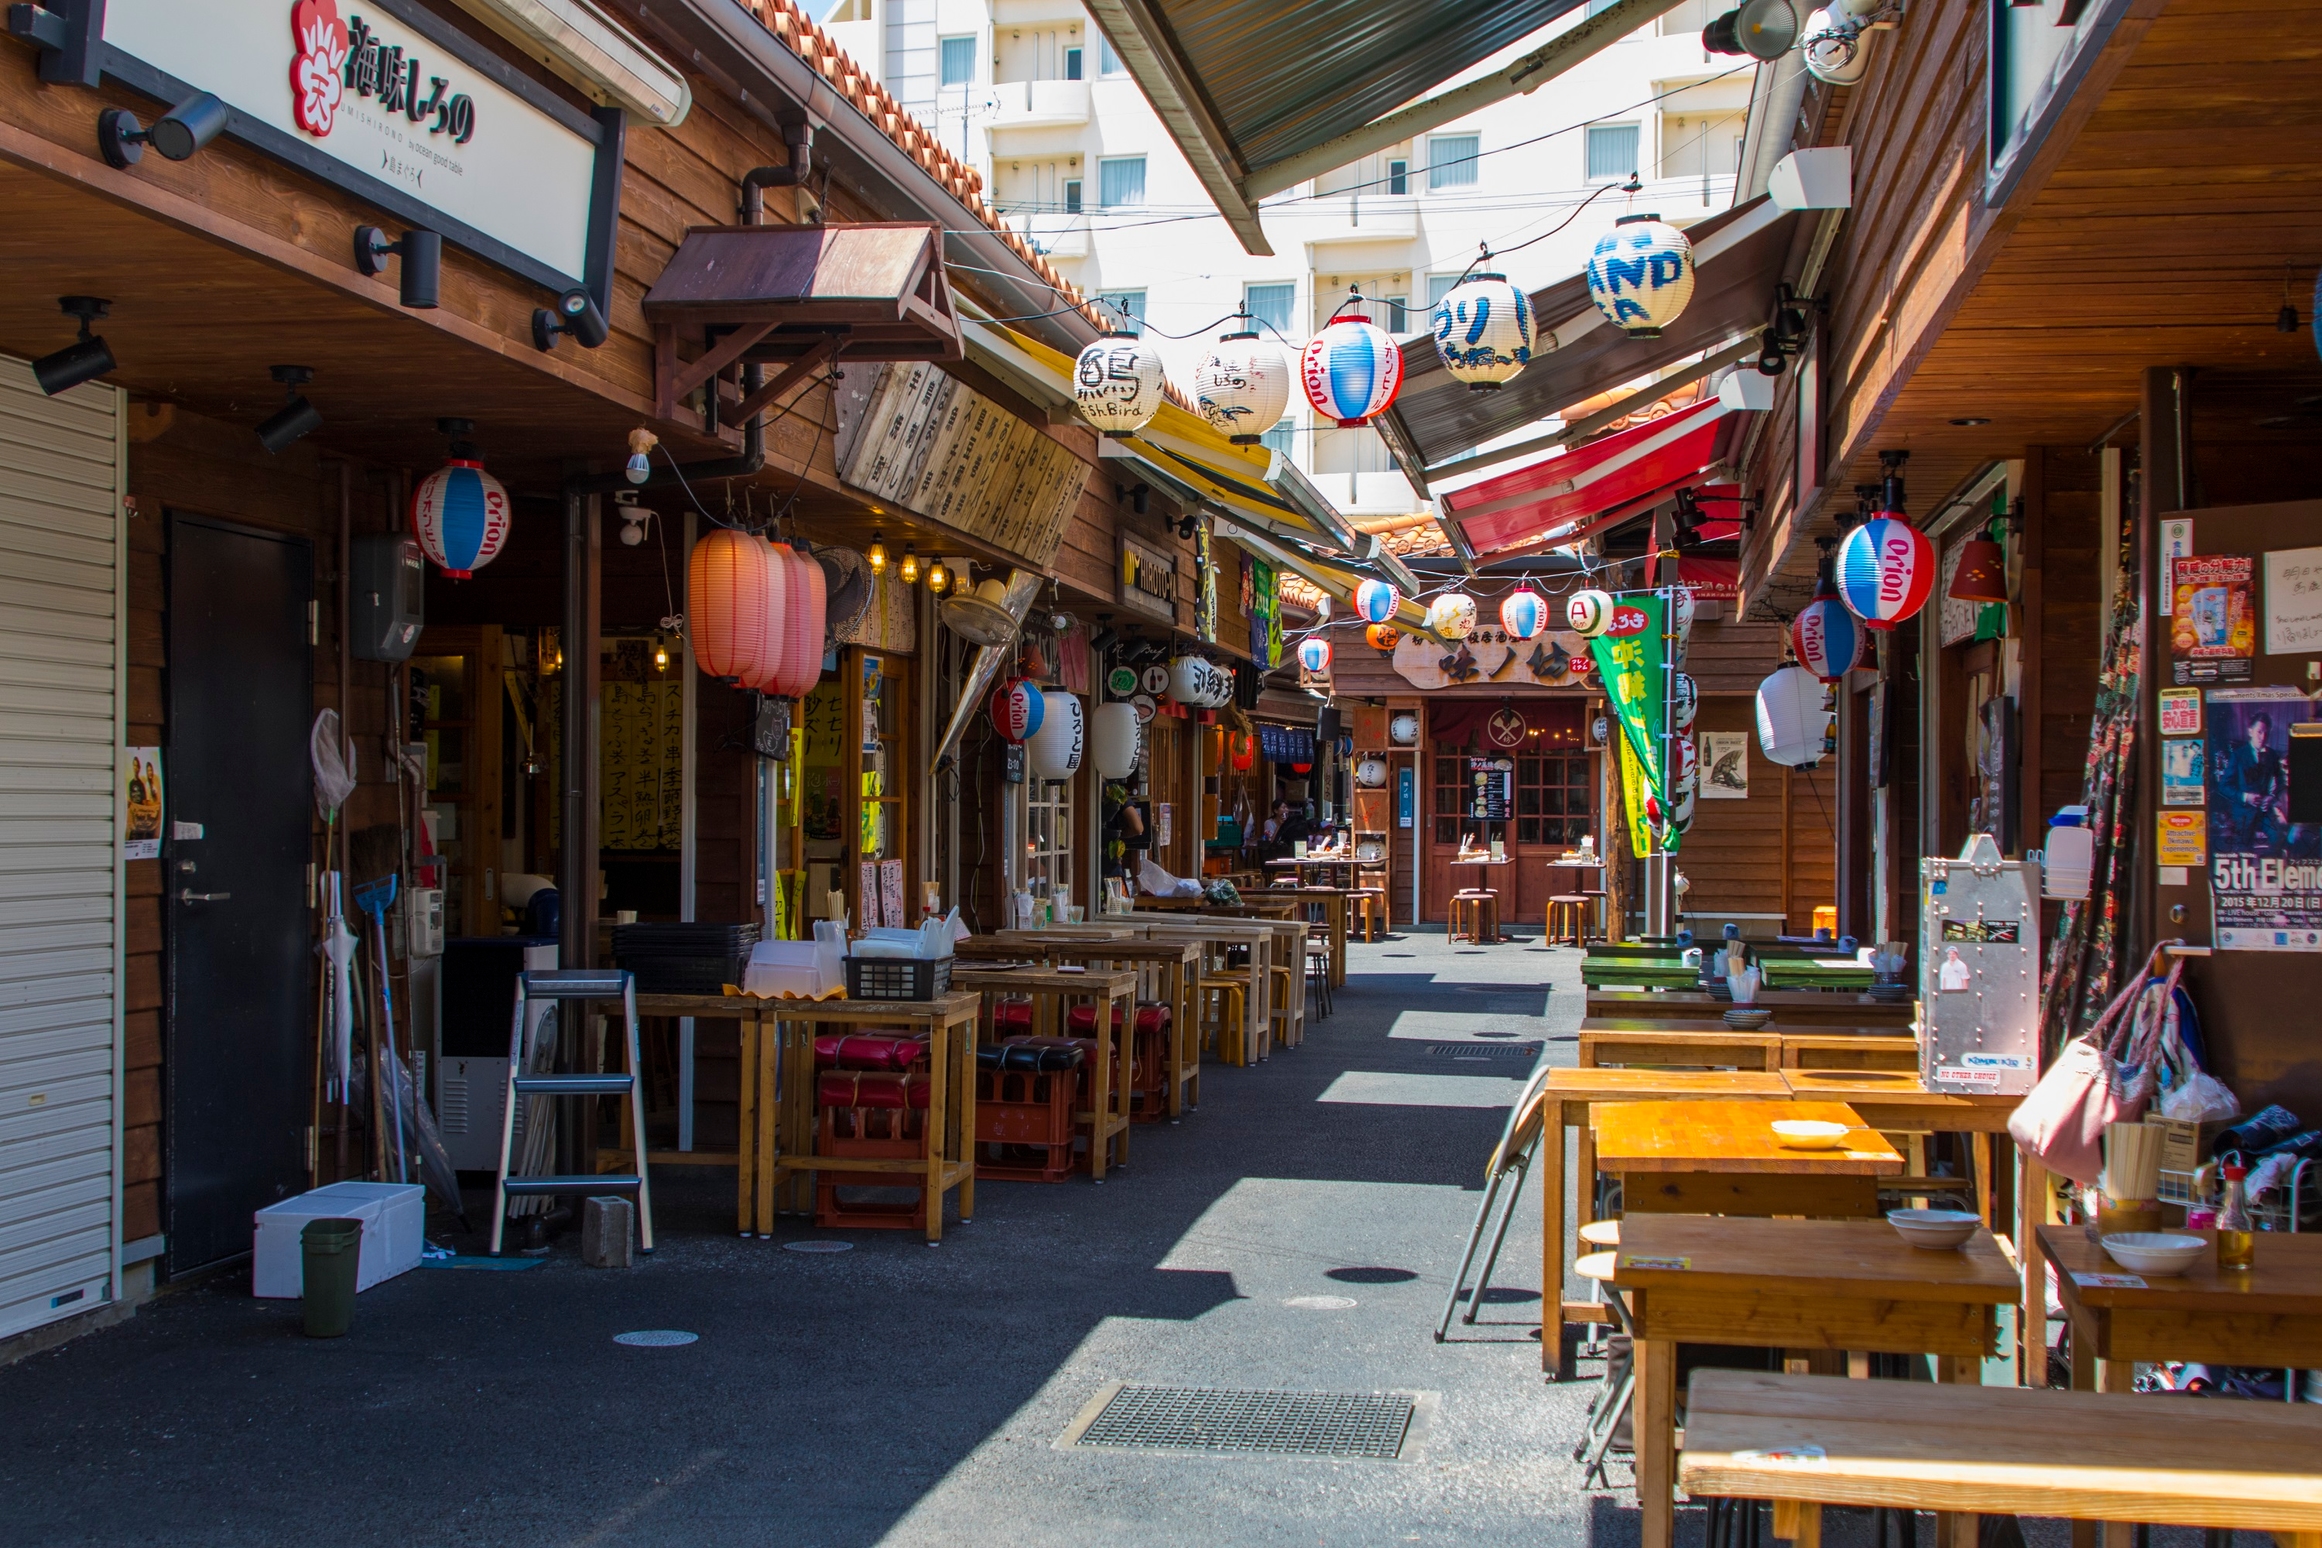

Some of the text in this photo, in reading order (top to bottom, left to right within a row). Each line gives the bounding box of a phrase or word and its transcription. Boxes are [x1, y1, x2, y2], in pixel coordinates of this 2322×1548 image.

[344, 15, 476, 144] 海味しろの
[341, 102, 403, 143] UMISHIRONO
[415, 143, 433, 160] ocean
[433, 153, 449, 168] good
[448, 158, 463, 176] table
[1307, 340, 1328, 404] Orion
[898, 386, 952, 501] はまぐり
[923, 399, 978, 512] スーチカー
[422, 475, 446, 561] オリオンビール
[480, 491, 506, 555] Orion
[1140, 558, 1178, 604] HIROTO-YA
[1880, 538, 1913, 602] Orion
[1571, 601, 1587, 619] A
[1806, 615, 1824, 662] Orion
[664, 684, 681, 763] スーチカー串
[1011, 692, 1027, 730] Orion
[2162, 710, 2198, 729] 安心宣言
[1066, 702, 1083, 769] ひろと屋
[2163, 845, 2199, 853] Experiences
[2166, 830, 2195, 838] Attractive
[2214, 859, 2253, 890] 5th
[1951, 1071, 1972, 1079] OTHER
[1974, 1072, 1997, 1081] CHOICE
